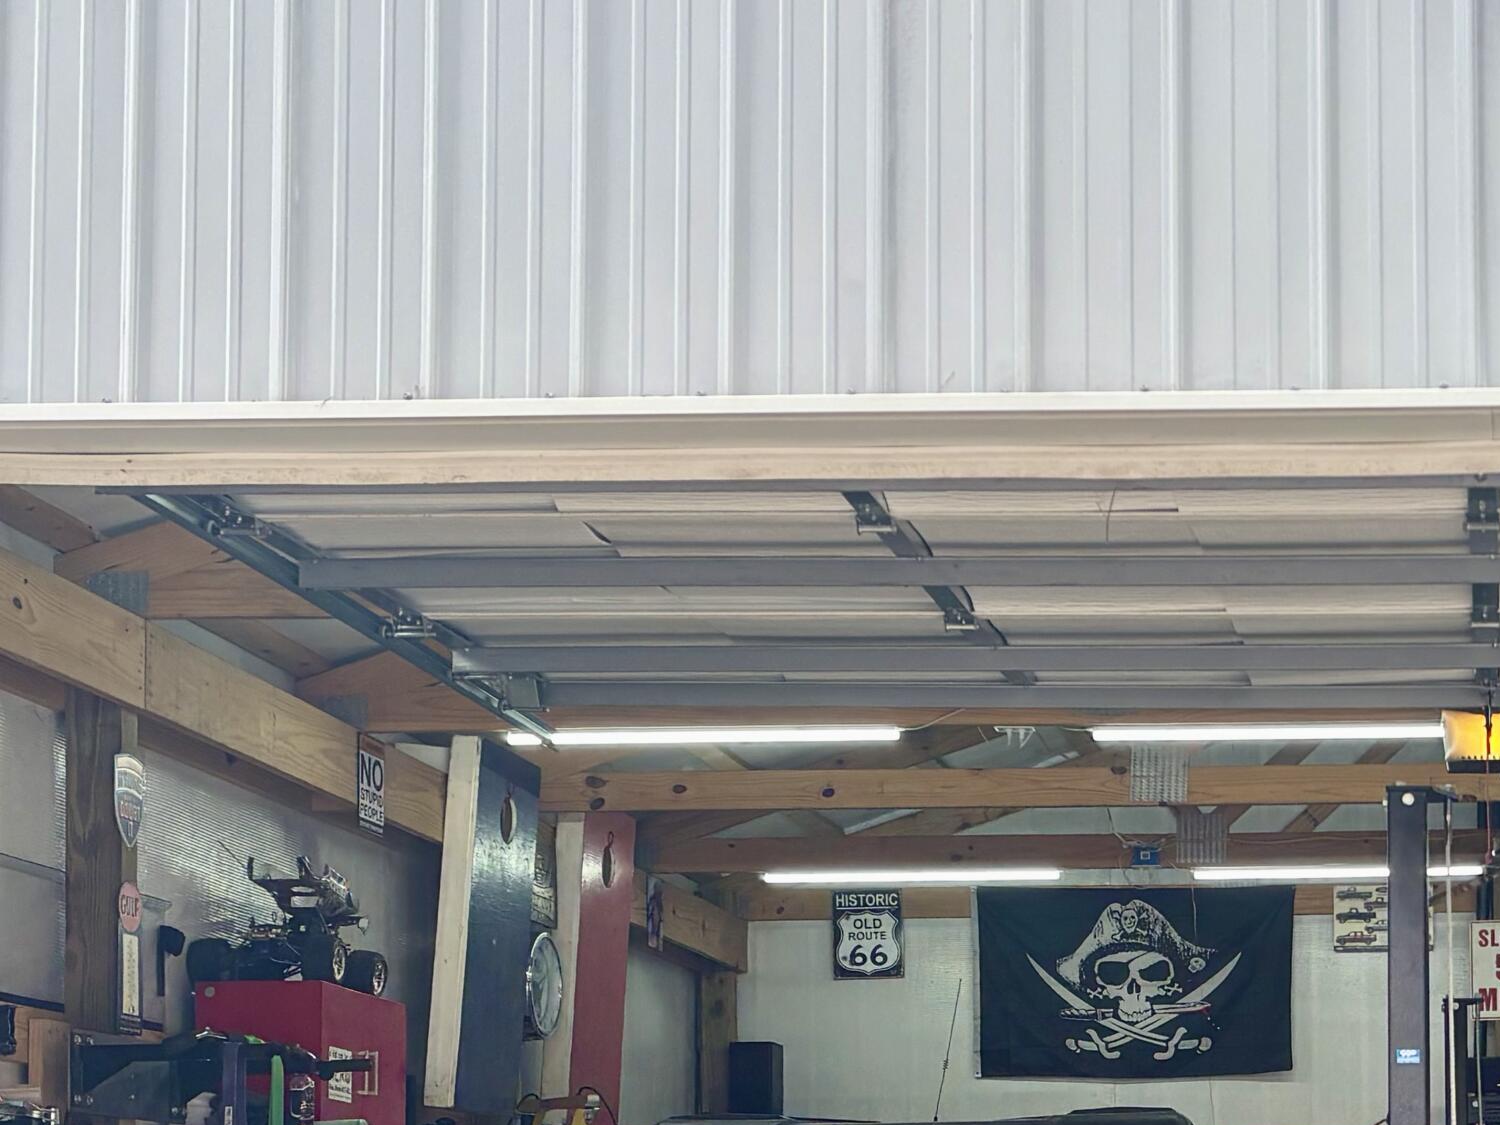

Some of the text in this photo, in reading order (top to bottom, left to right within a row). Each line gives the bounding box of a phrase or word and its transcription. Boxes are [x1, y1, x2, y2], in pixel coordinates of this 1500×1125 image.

[361, 753, 383, 792] NO
[361, 787, 383, 807] STUPID
[360, 803, 384, 822] PEOPLE
[836, 893, 898, 907] HISTORIC
[853, 918, 882, 929] OLD
[848, 931, 887, 940] ROUTE
[850, 944, 888, 966] 66
